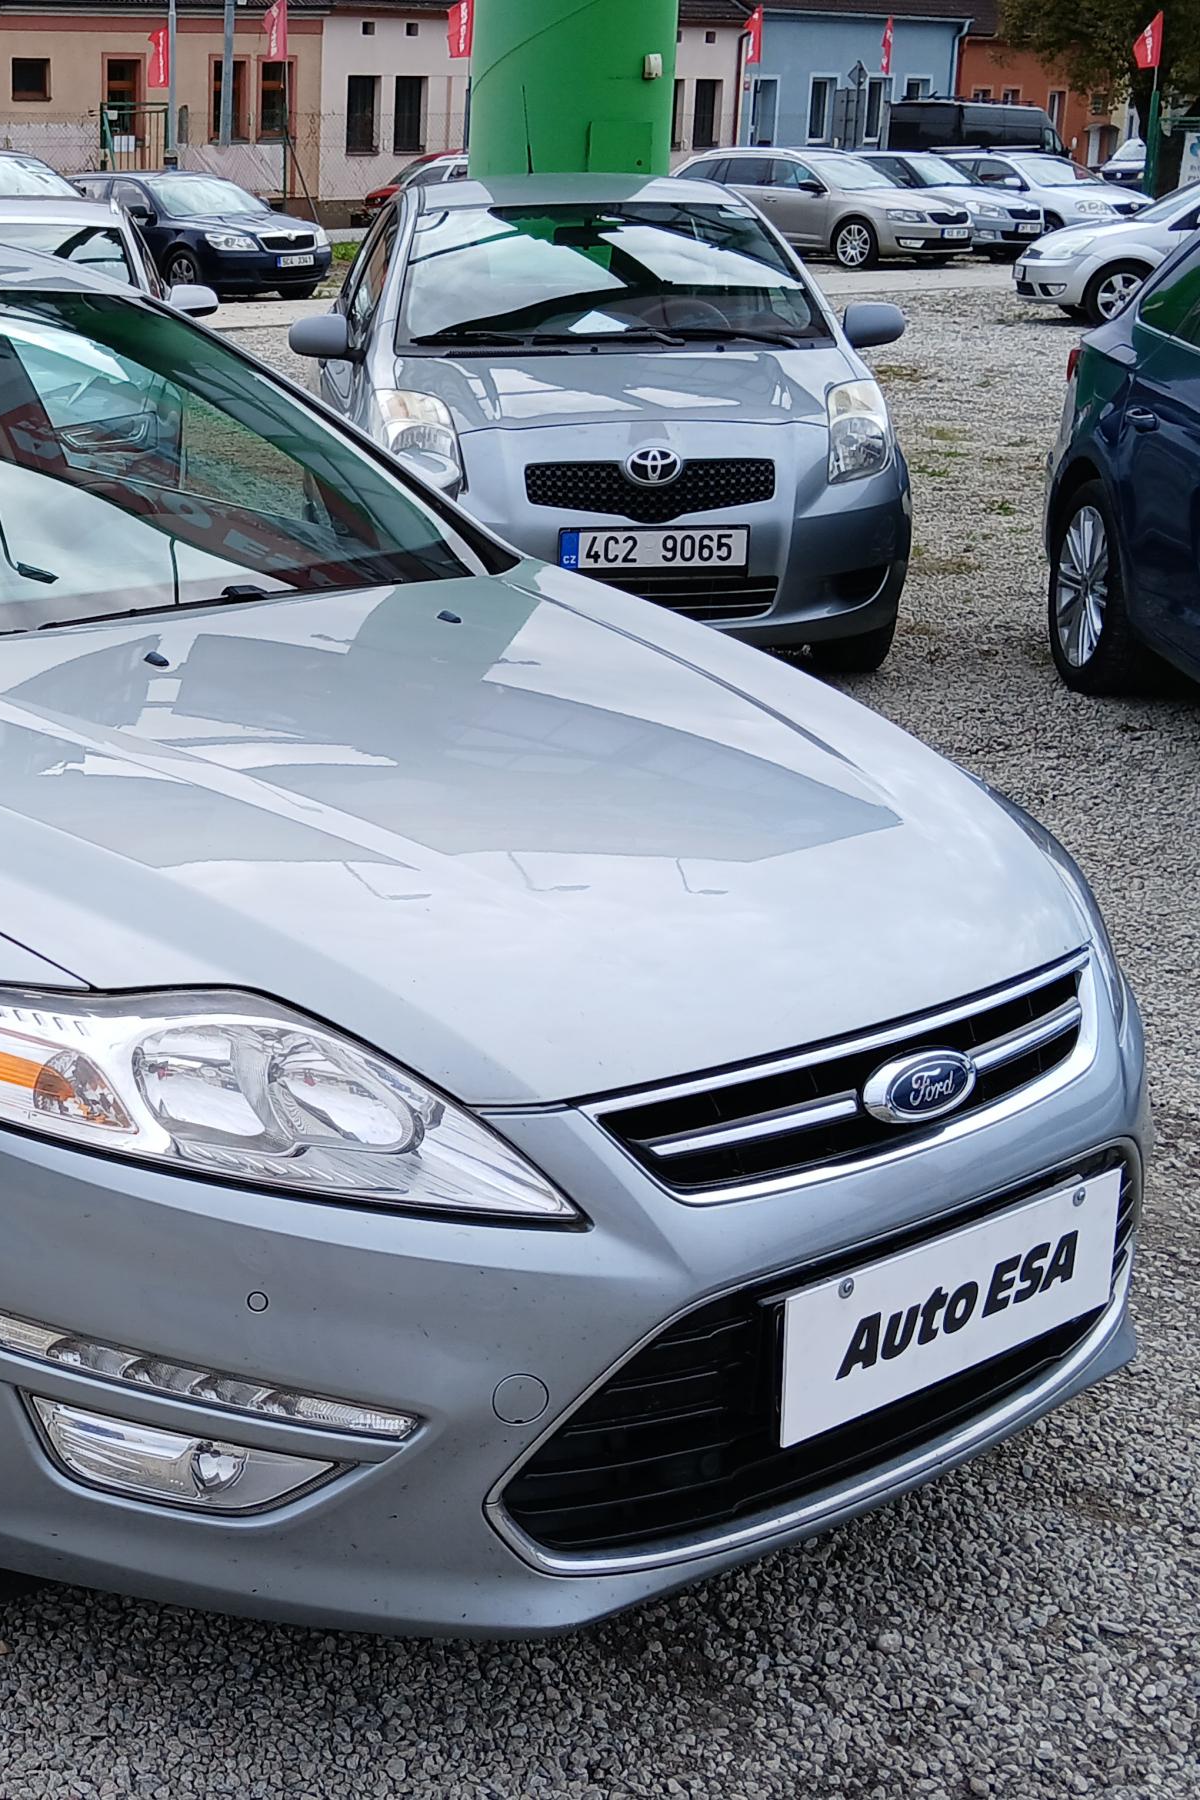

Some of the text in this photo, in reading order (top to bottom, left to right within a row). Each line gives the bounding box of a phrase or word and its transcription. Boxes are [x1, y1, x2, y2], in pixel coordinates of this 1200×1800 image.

[562, 555, 577, 564] CZ
[585, 533, 733, 564] 4C2 9065
[909, 1067, 956, 1107] Ford
[835, 1229, 1079, 1381] Auto ESA
